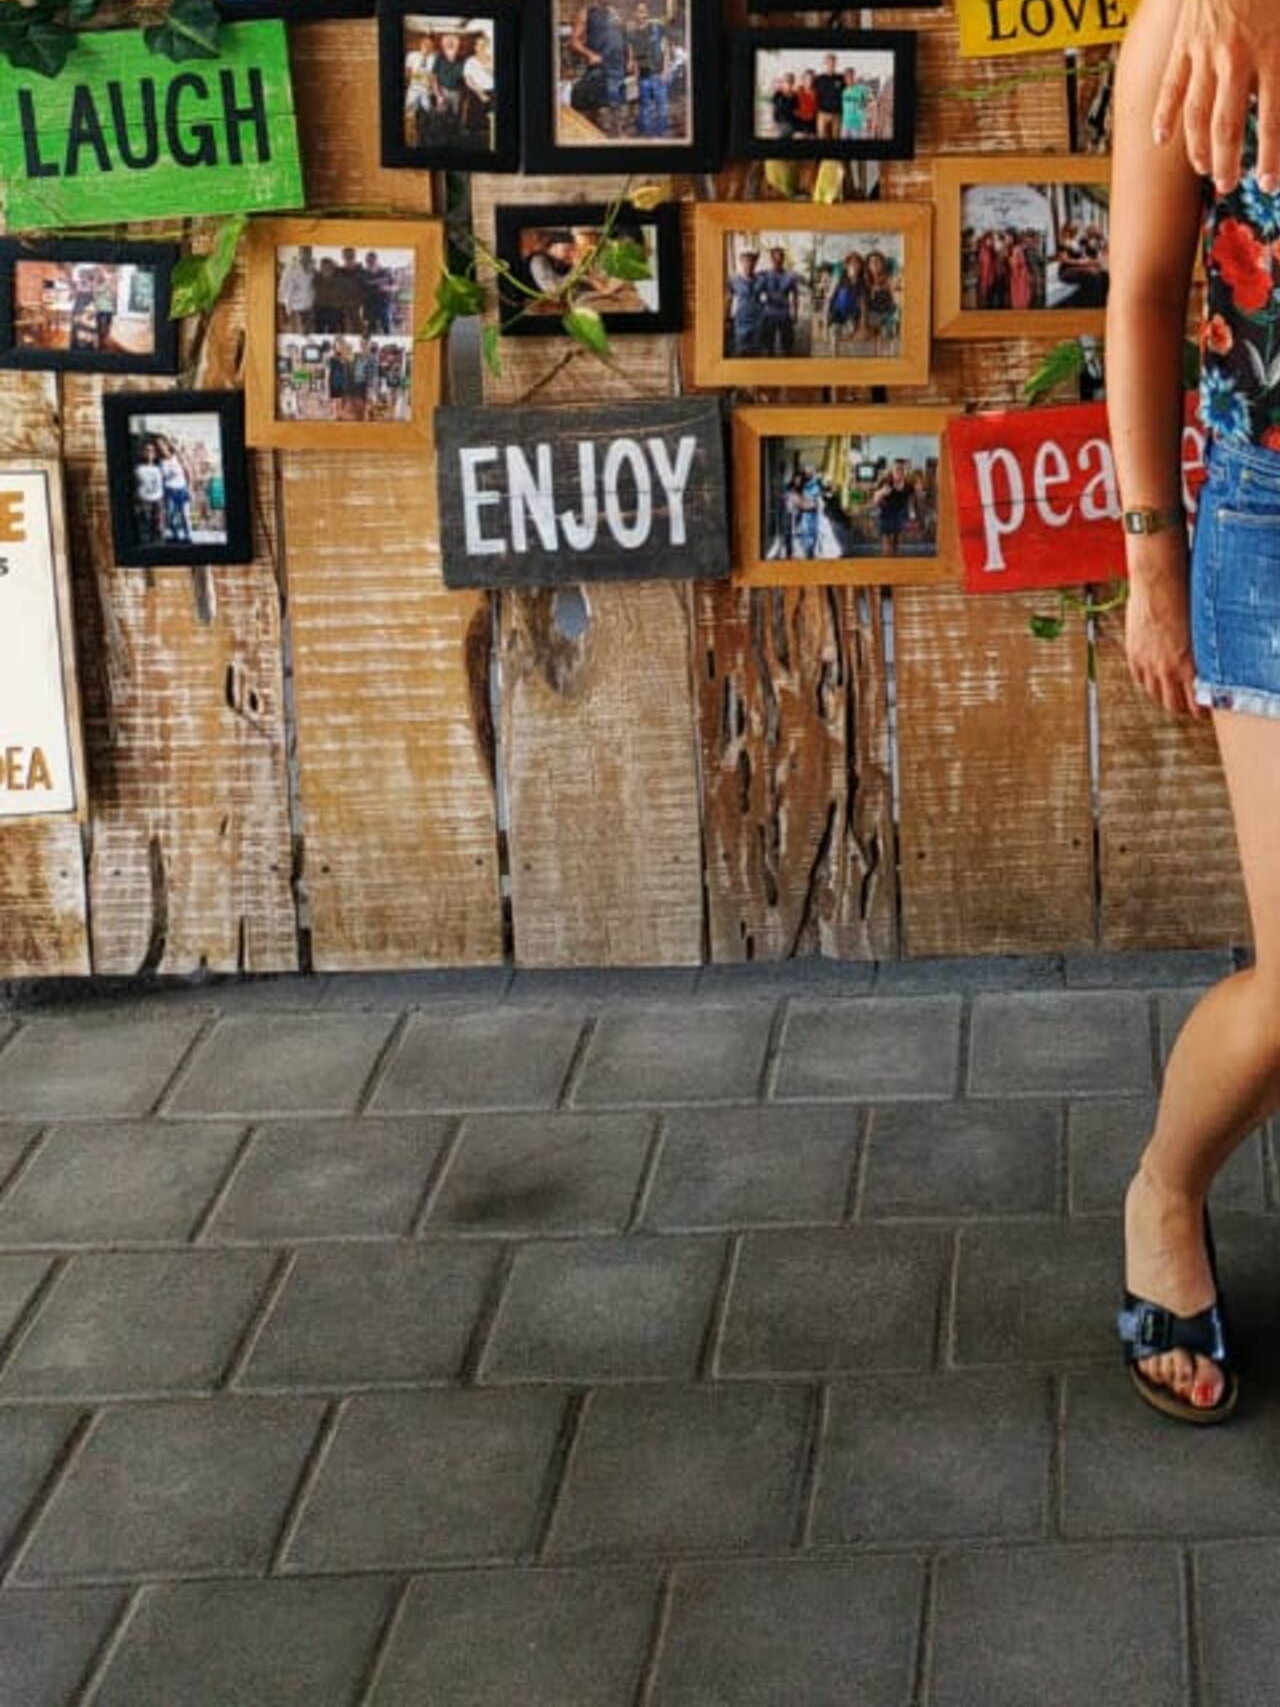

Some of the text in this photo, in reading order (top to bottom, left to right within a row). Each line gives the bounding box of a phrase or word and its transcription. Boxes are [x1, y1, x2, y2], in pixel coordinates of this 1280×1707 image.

[17, 66, 272, 179] LAUGH
[457, 435, 698, 557] ENJOY
[973, 424, 1207, 573] peae
